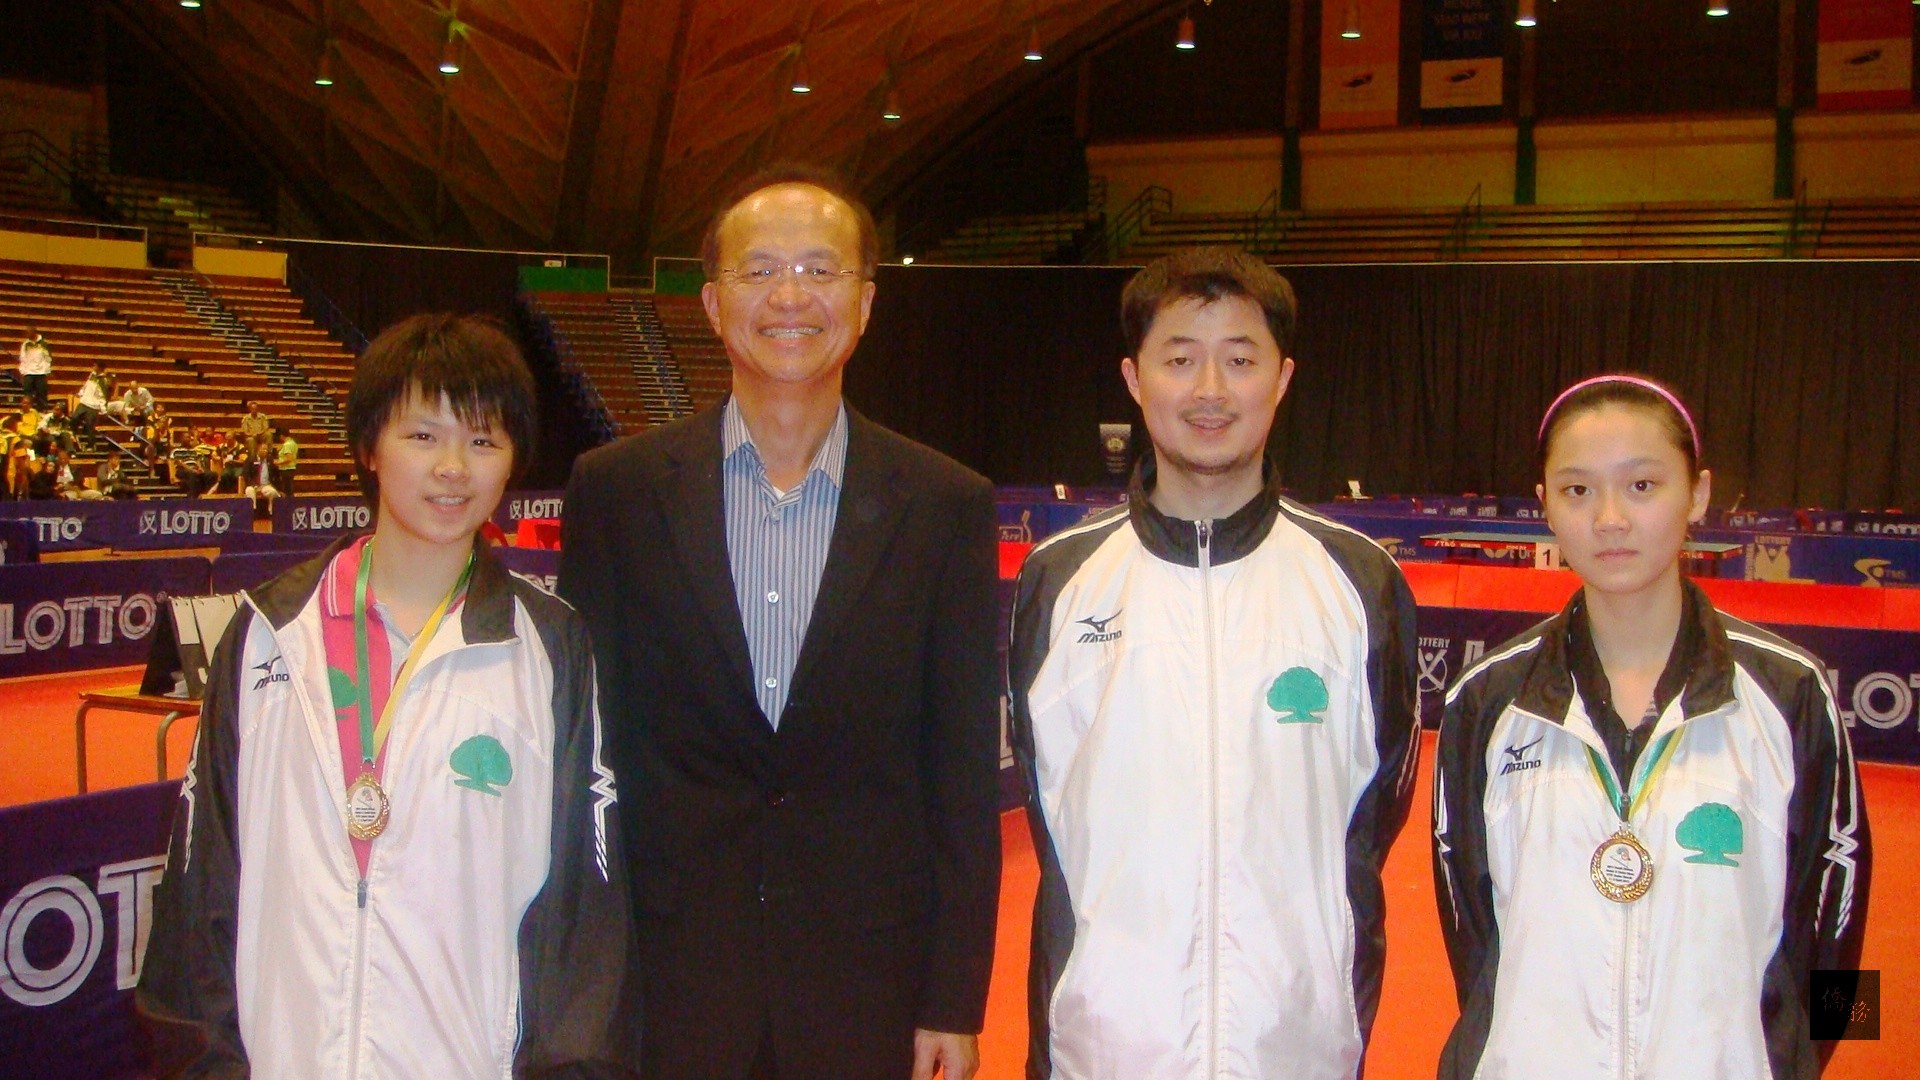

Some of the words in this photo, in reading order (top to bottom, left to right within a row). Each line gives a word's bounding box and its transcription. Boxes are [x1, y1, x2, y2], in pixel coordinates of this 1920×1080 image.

[311, 506, 370, 529] LOTTO
[524, 499, 563, 519] LOTT
[20, 516, 83, 542] TTO
[160, 510, 231, 534] LOTTO
[1542, 549, 1551, 566] 1
[0, 593, 157, 654] LOTTO
